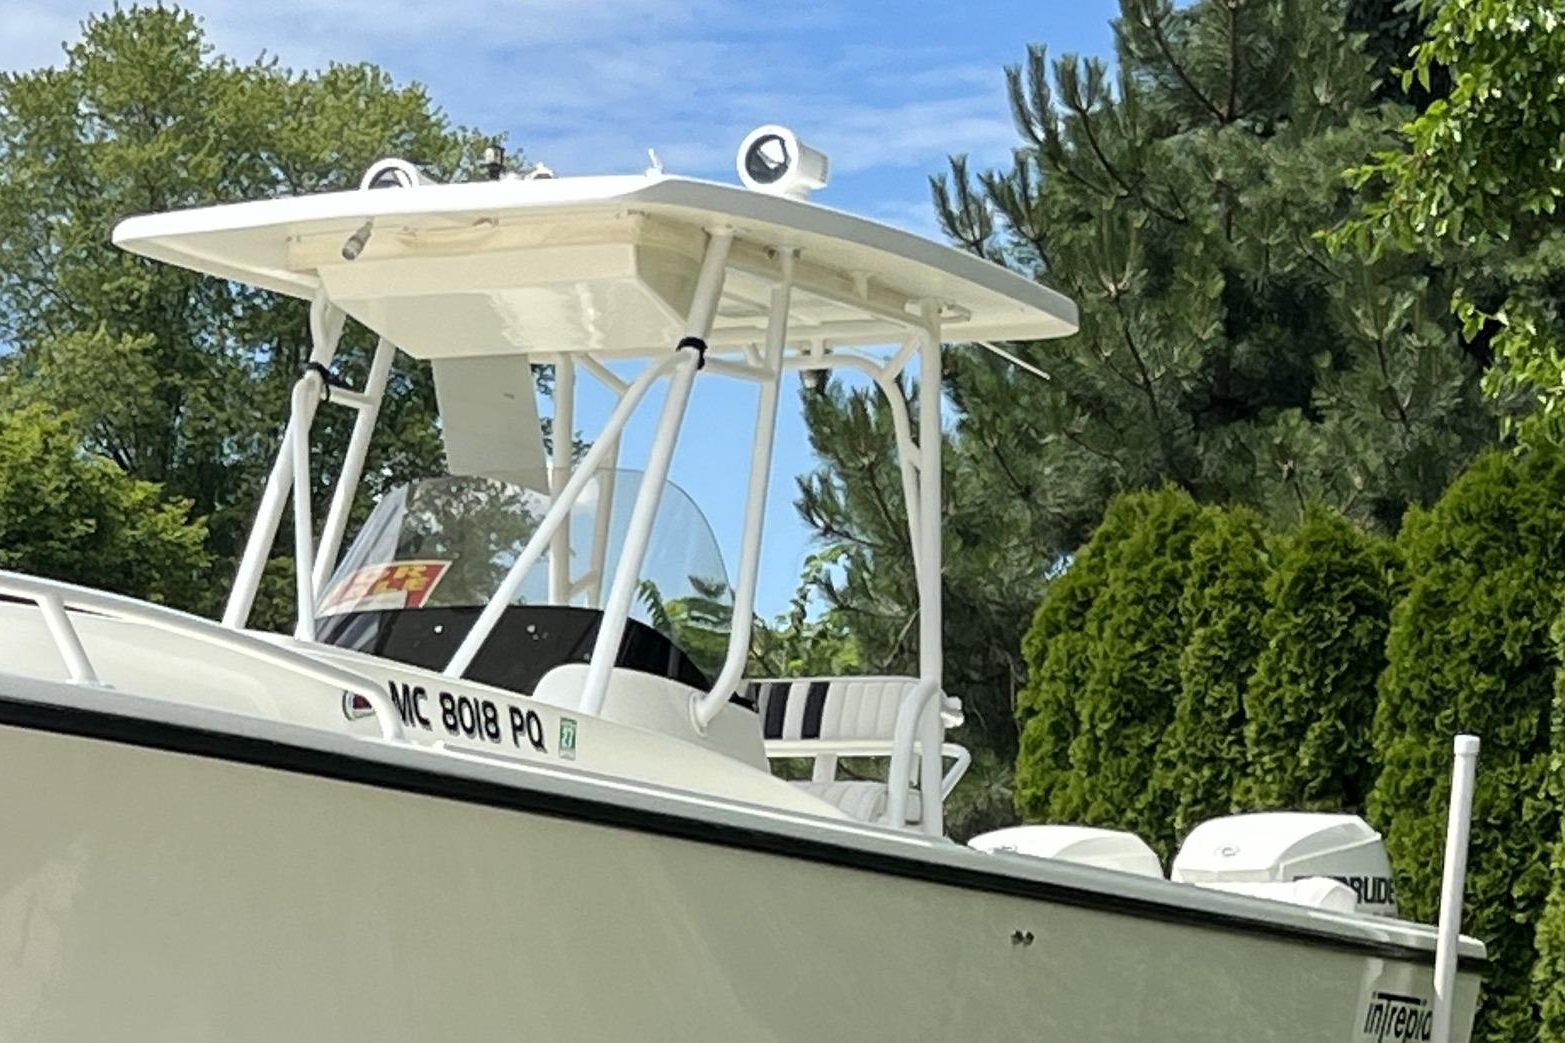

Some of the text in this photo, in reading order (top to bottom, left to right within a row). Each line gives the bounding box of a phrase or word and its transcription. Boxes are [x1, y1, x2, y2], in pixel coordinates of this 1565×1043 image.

[388, 680, 548, 753] MC 8018 PQ
